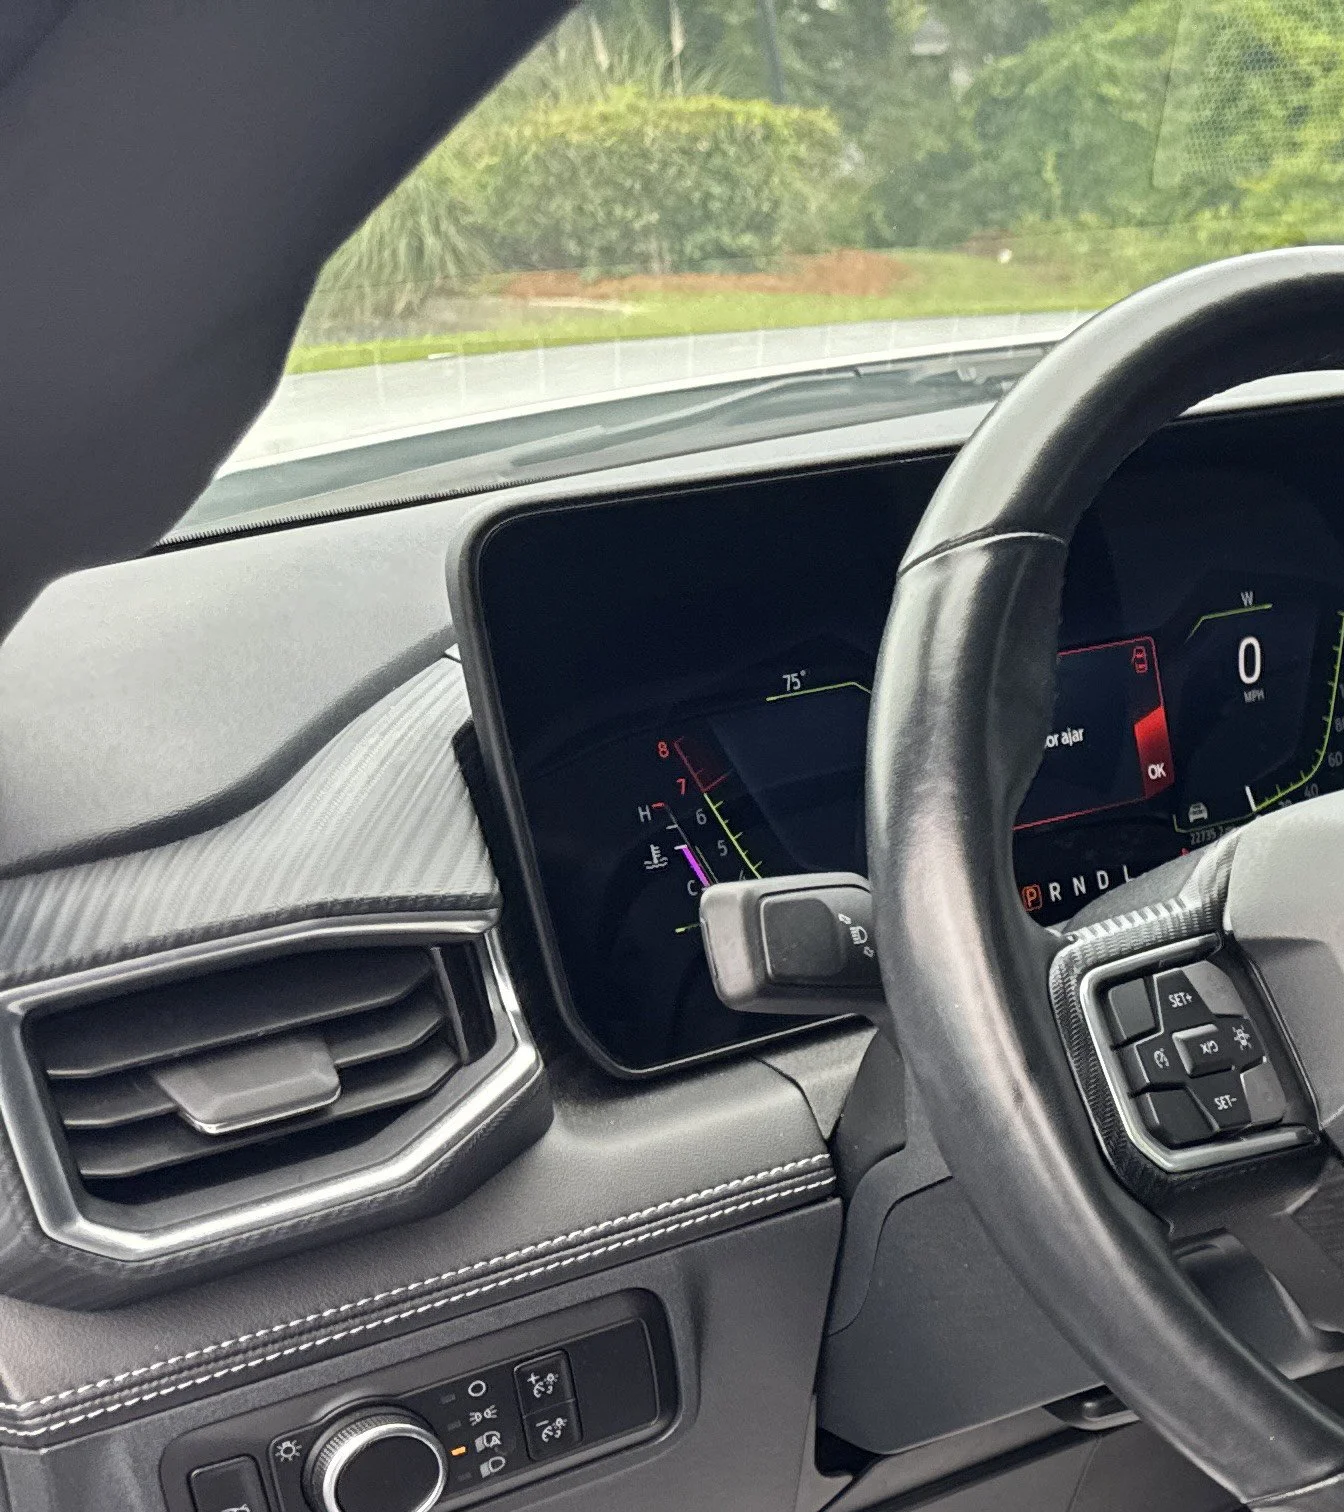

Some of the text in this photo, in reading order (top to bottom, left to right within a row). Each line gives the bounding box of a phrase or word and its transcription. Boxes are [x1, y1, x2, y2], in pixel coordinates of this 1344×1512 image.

[1241, 591, 1254, 606] W
[1238, 636, 1262, 684] 0
[1061, 722, 1085, 747] ajar
[657, 741, 669, 759] 8
[1147, 763, 1166, 780] OK
[676, 778, 687, 796] 7
[638, 805, 652, 823] H
[696, 809, 707, 825] 6
[717, 840, 729, 857] 5
[687, 880, 698, 896] C
[1048, 883, 1062, 902] R
[1072, 877, 1087, 896] N
[1097, 869, 1109, 890] D
